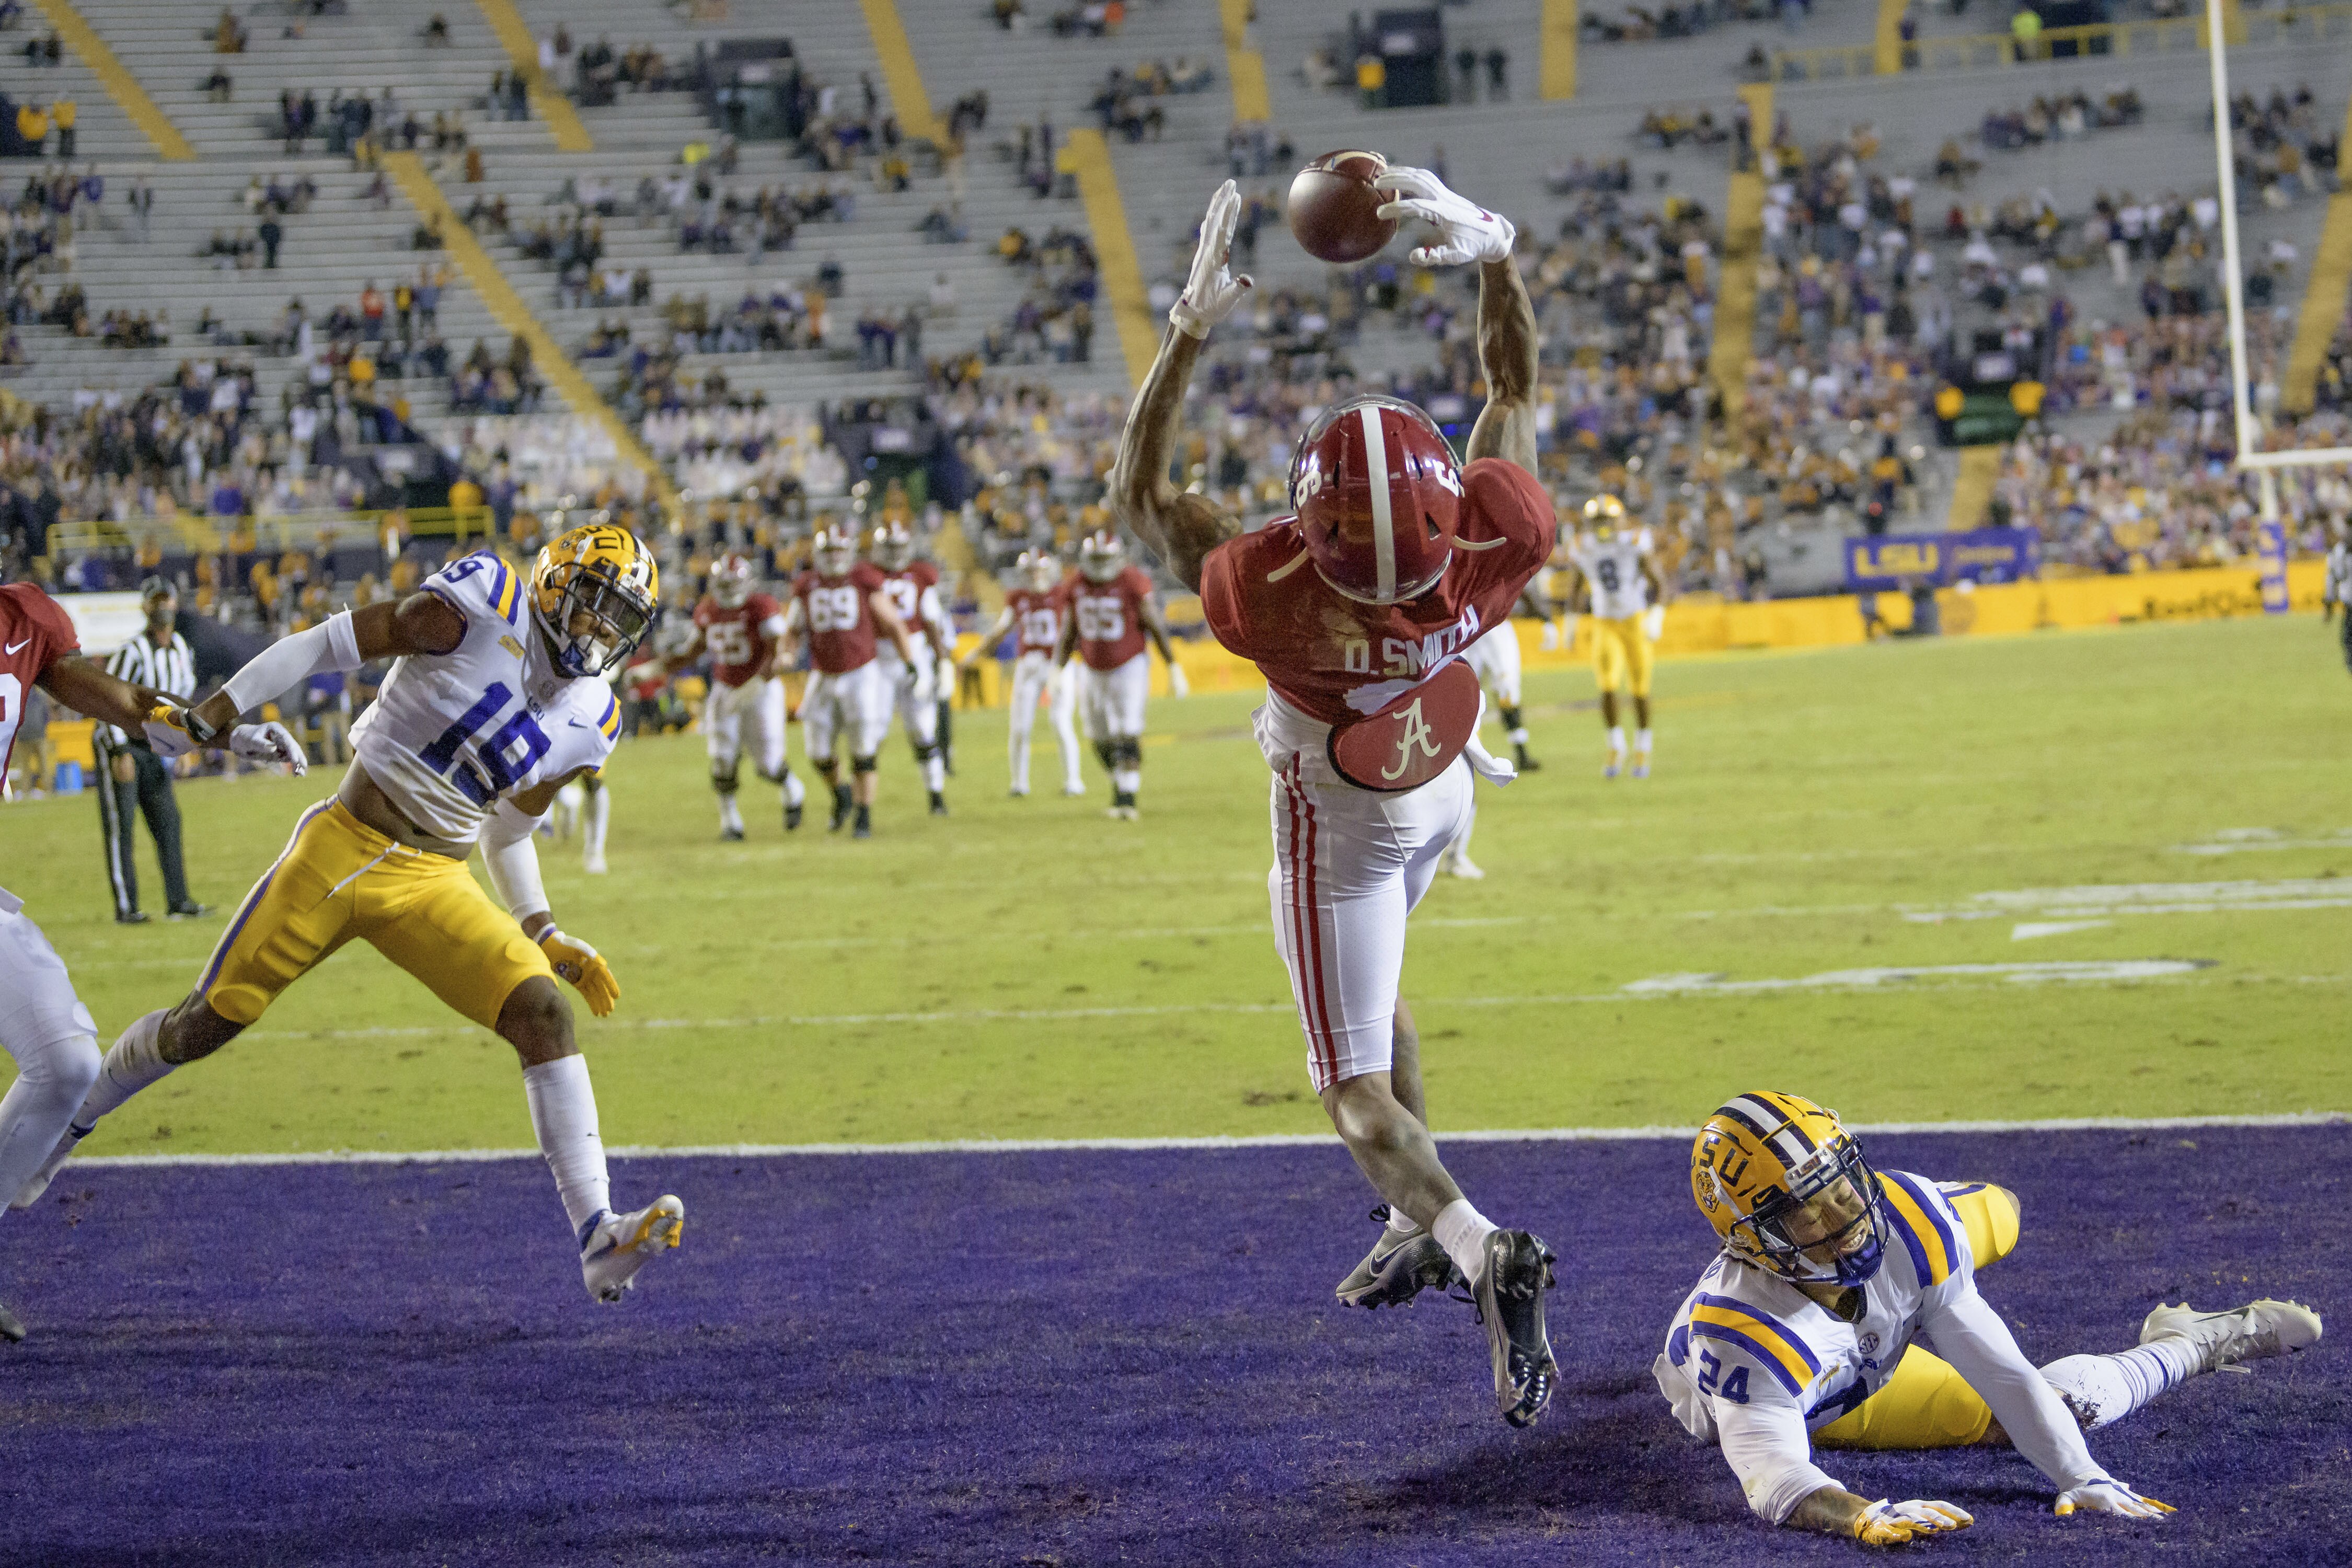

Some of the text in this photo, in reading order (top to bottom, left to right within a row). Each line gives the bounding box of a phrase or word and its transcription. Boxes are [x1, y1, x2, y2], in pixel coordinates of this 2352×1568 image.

[809, 586, 860, 631] 69
[1076, 596, 1124, 641] 65
[417, 681, 552, 809] 19
[1381, 697, 1442, 780] A
[1692, 1137, 1749, 1187] SU
[1698, 1348, 1750, 1404] 24
